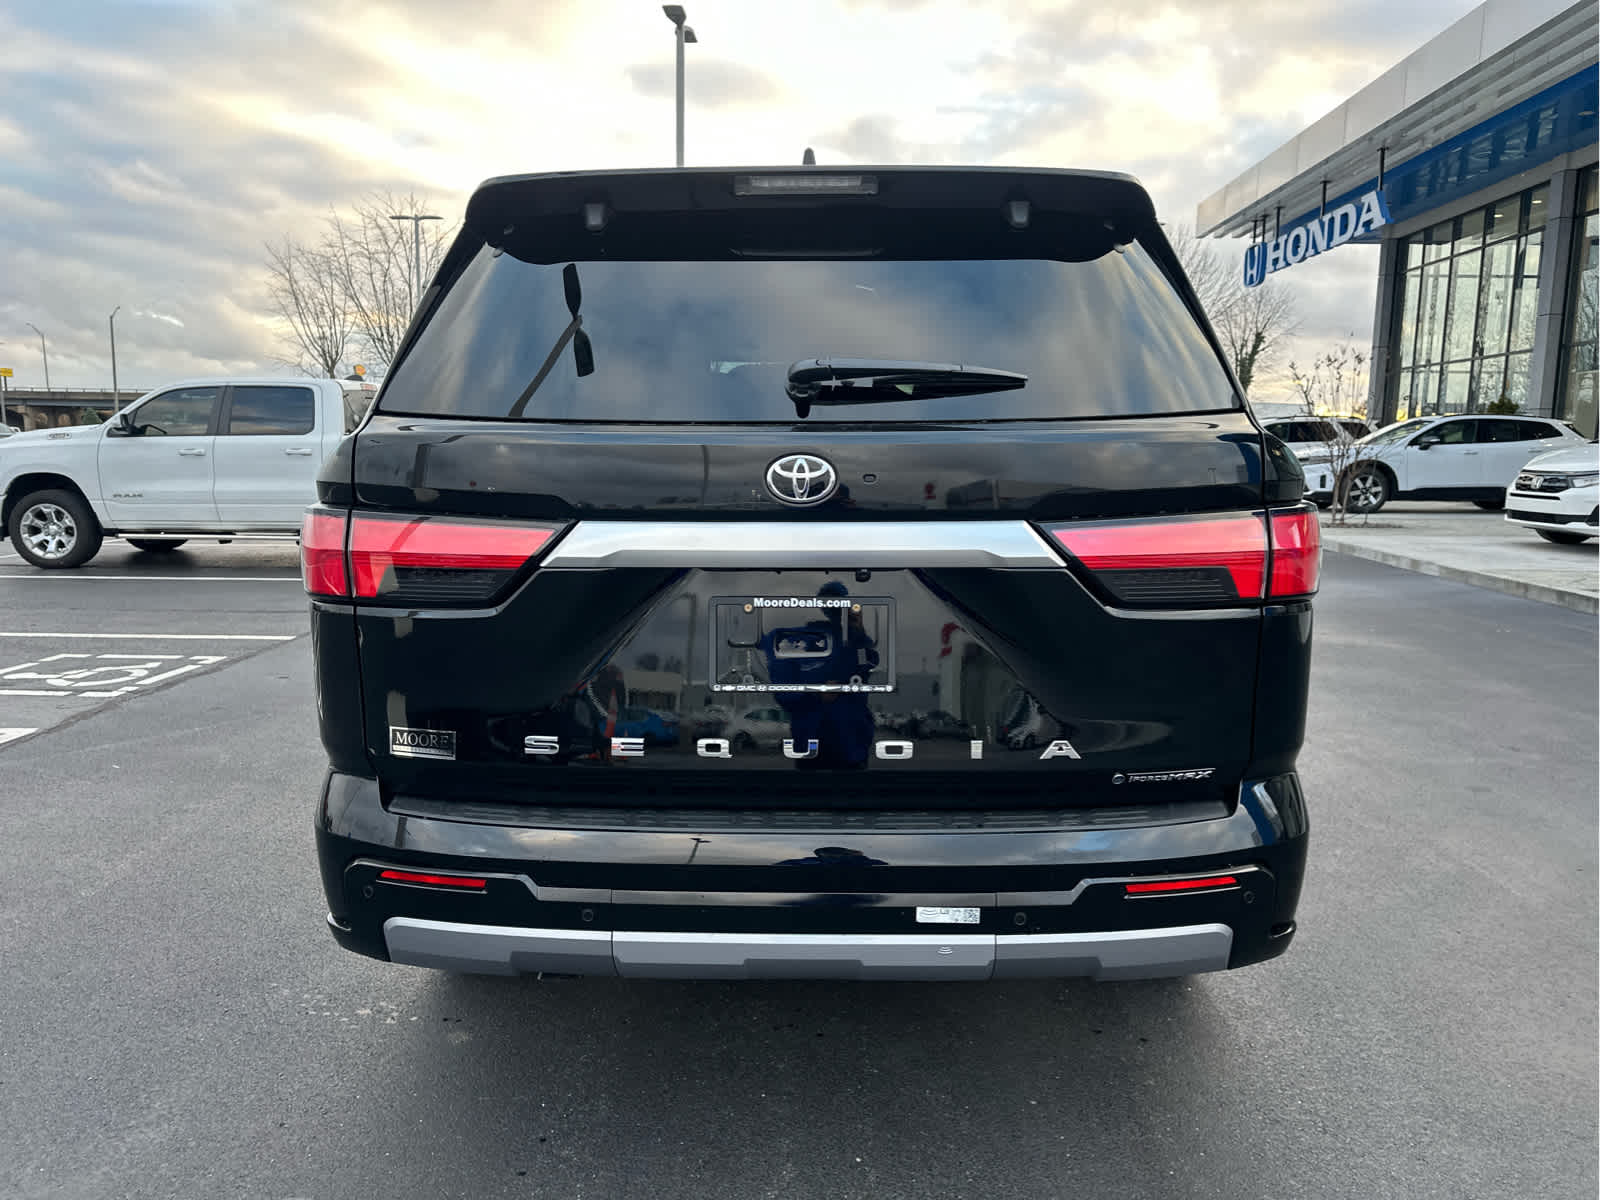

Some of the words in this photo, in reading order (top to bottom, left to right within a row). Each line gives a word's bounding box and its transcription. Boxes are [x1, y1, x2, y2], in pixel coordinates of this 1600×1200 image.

[1266, 190, 1387, 273] HONDA
[753, 597, 851, 608] MooreDeals.com
[395, 731, 449, 749] MOORE
[523, 735, 1081, 760] SEQUOIA
